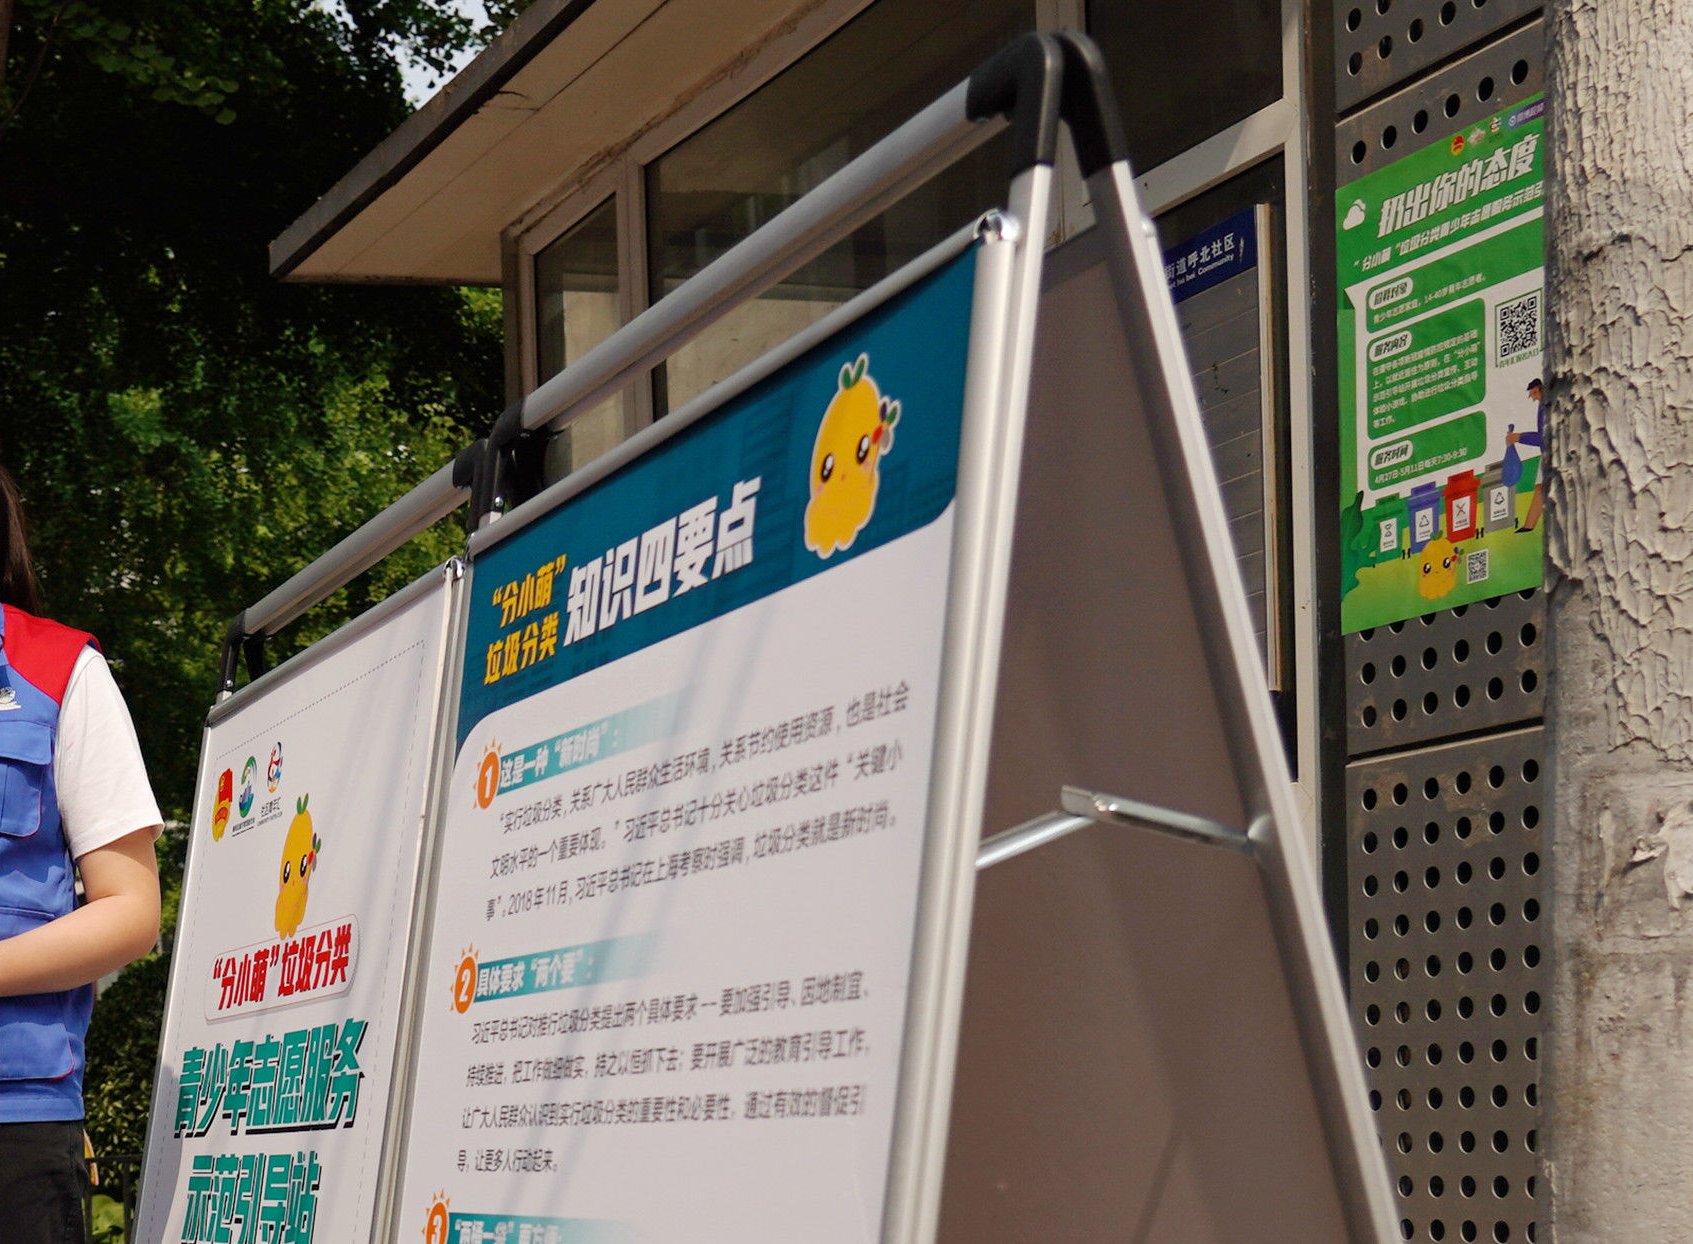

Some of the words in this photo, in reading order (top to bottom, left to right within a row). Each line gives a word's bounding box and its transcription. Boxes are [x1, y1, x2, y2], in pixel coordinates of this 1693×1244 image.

[1377, 133, 1541, 240] 扔出你的态度
[1198, 253, 1235, 275] Community
[492, 554, 566, 627] “分小萌”
[563, 477, 762, 648] 知识四要点
[483, 612, 559, 686] 垃圾分类
[482, 763, 494, 801] 1
[212, 922, 352, 1010] “分小萌”垃圾分类
[457, 967, 472, 1003] 2
[174, 1018, 368, 1138] 青少年志愿服务
